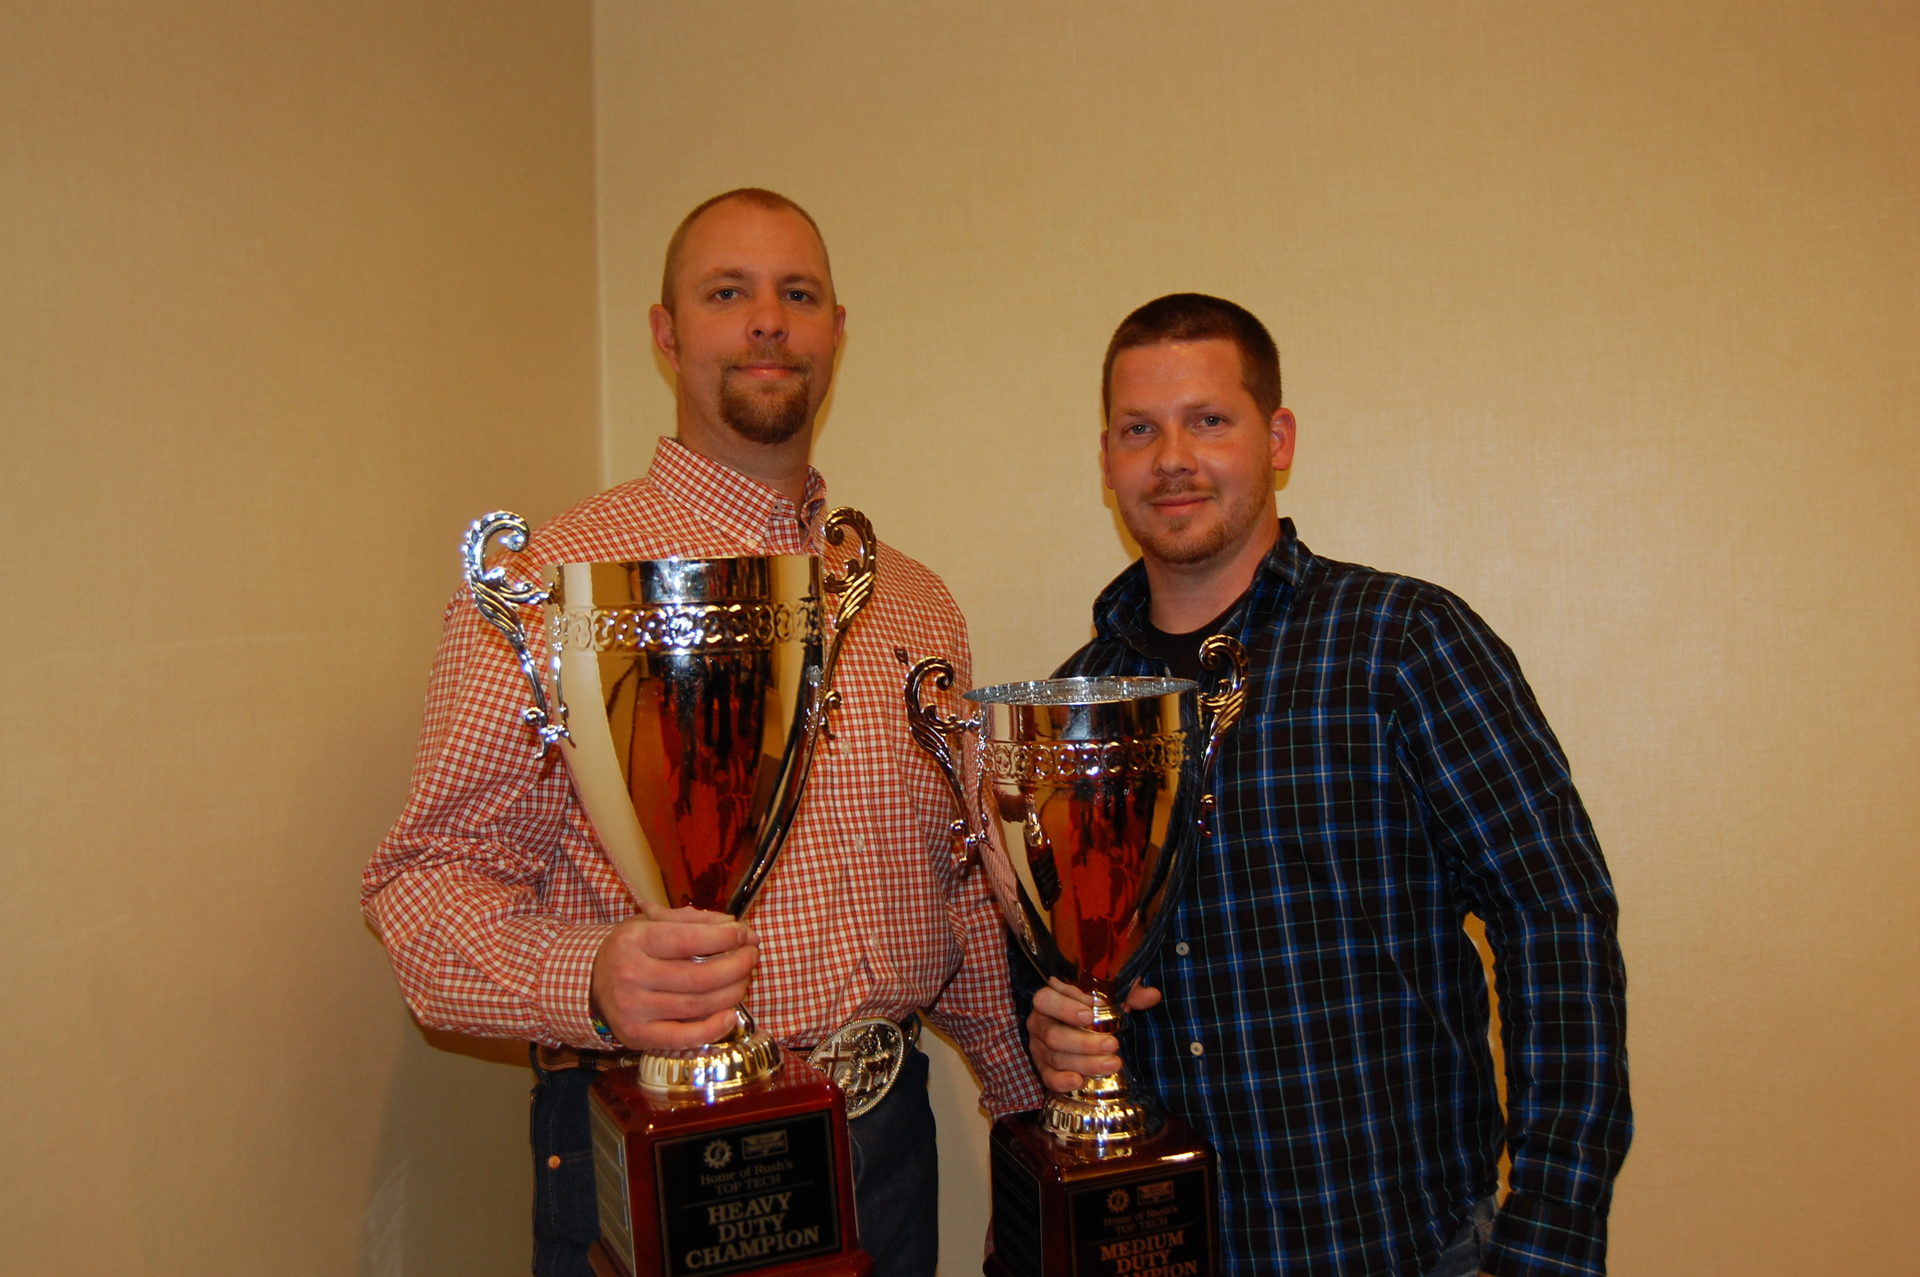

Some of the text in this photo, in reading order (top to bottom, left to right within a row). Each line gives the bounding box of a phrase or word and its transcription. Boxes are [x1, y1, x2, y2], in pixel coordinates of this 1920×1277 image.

[701, 1159, 794, 1185] Home of Rush's
[715, 1174, 781, 1196] TOP TECH
[707, 1191, 793, 1225] HEAVY
[718, 1213, 786, 1243] DUTY
[1115, 1223, 1137, 1235] TOP
[685, 1226, 820, 1269] CHAMPION
[1100, 1230, 1185, 1262] MEDIUM
[1112, 1260, 1198, 1277] PION
[1116, 1249, 1171, 1275] DUTY
